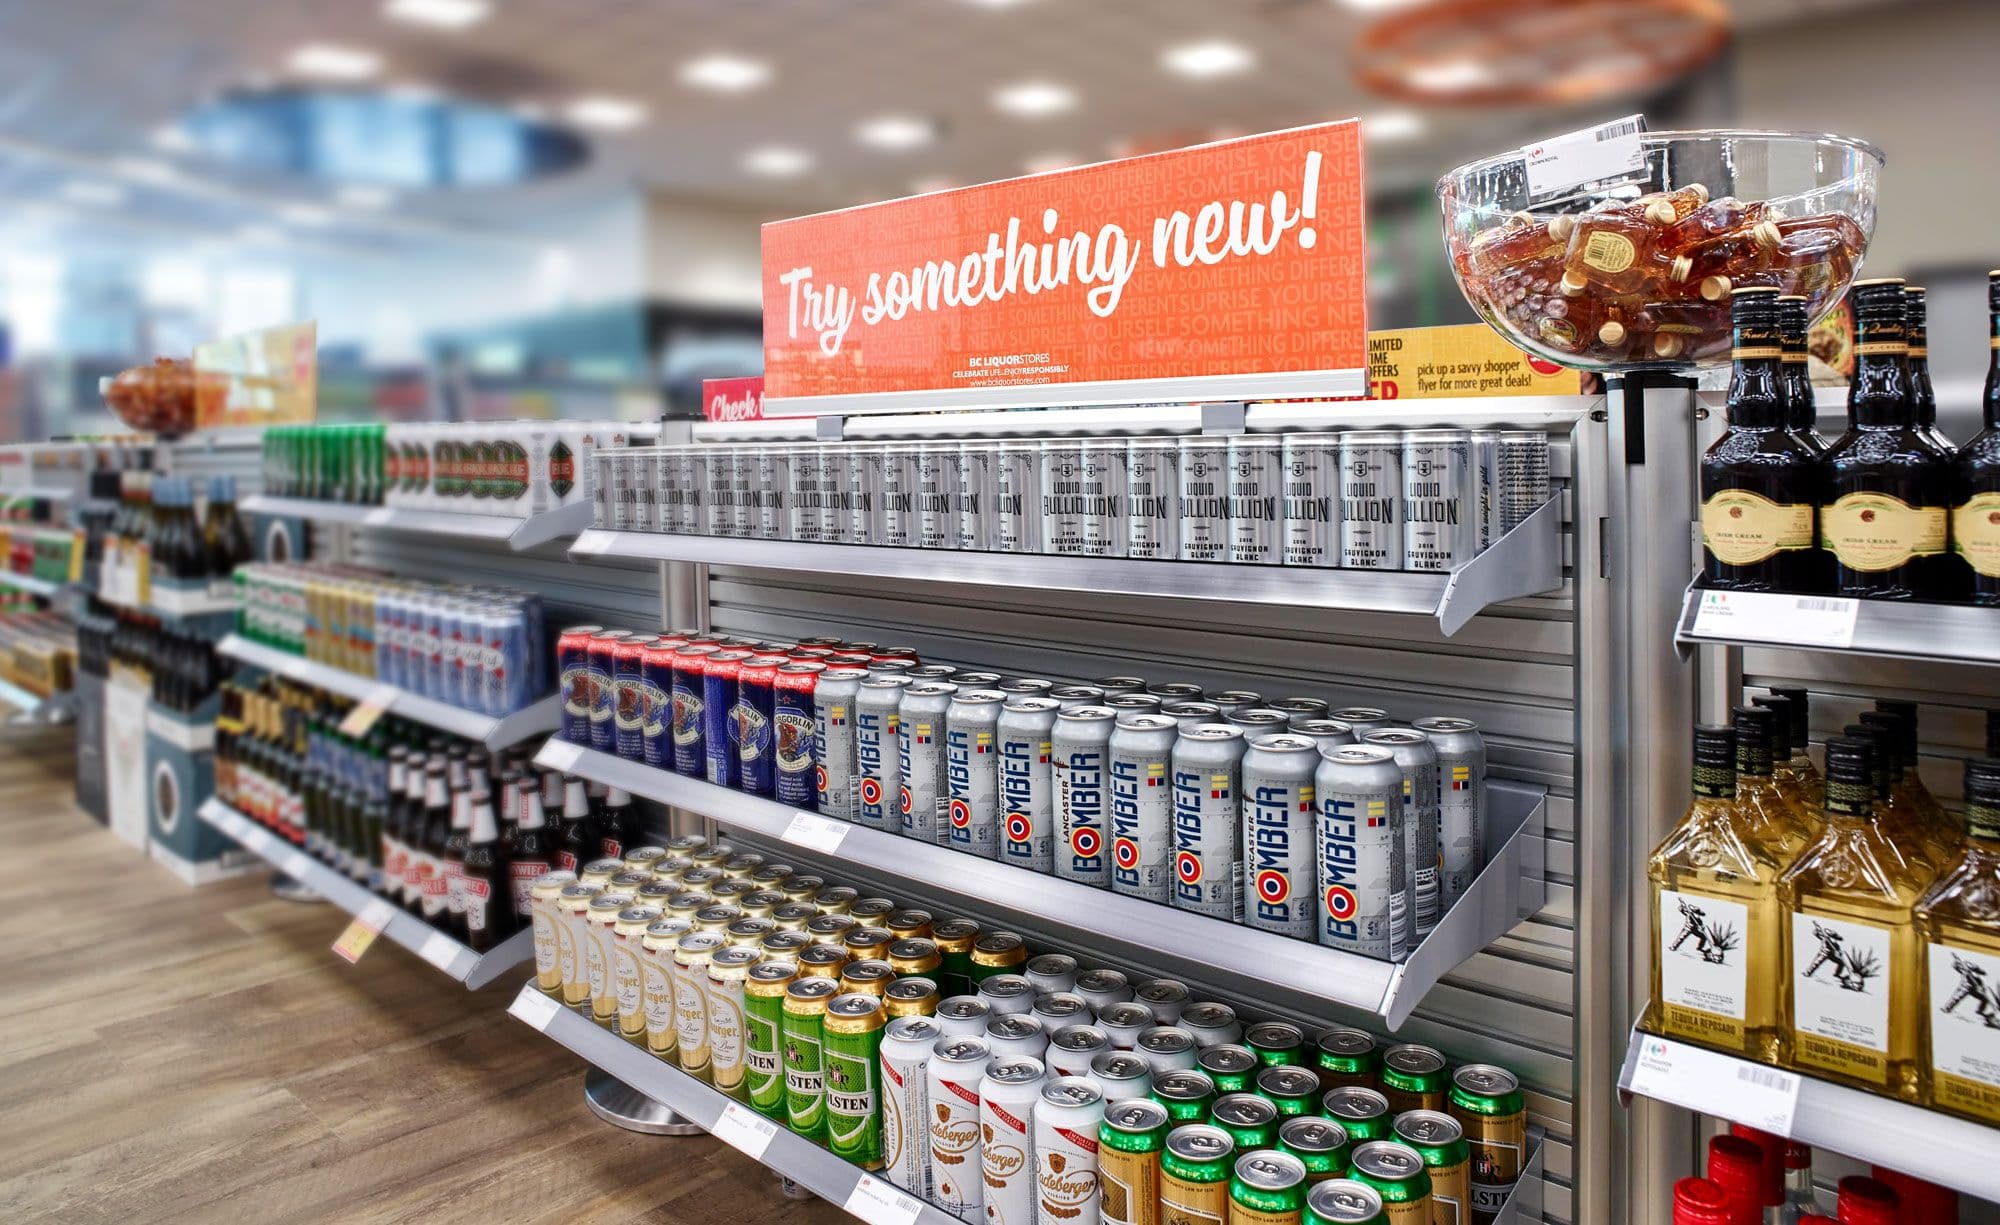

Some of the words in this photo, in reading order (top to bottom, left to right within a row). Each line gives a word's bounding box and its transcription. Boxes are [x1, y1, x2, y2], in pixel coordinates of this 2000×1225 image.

[780, 267, 856, 356] Try
[863, 208, 1140, 318] something
[1153, 150, 1322, 268] new!
[969, 358, 982, 367] BC
[984, 353, 1050, 367] LIQUORSTORES
[953, 369, 988, 378] CELEBRATE
[1417, 364, 1434, 378] pick
[1437, 364, 1448, 378] up
[1451, 365, 1455, 373] a
[1457, 362, 1481, 378] savvy
[1484, 359, 1520, 377] shopper
[1418, 378, 1437, 394] flyer
[1439, 377, 1451, 390] for
[1454, 379, 1477, 390] more
[1480, 377, 1502, 393] great
[1505, 376, 1532, 388] deals!
[711, 390, 758, 422] Check
[1053, 481, 1081, 495] LIQUID
[1186, 482, 1214, 496] LIQUID
[1232, 482, 1258, 496] LIQUID
[1286, 482, 1312, 497] LIQUID
[1346, 482, 1376, 497] LIQUID
[1409, 482, 1440, 498] LIQUID
[1043, 496, 1083, 517] BULLIO
[1191, 551, 1216, 559] BLANC
[1236, 553, 1259, 561] BLANC
[1290, 556, 1313, 564] BLANC
[1344, 549, 1387, 557] SAUVIGNON
[1408, 551, 1452, 559] SAUVIGNON
[1351, 558, 1377, 566] BLANC
[1414, 561, 1442, 569] BLANC
[859, 714, 882, 819] BOMBER
[949, 731, 971, 843] BOMBER
[1004, 741, 1032, 858] BOMBER
[1070, 753, 1102, 873] BOMBER
[1114, 761, 1140, 887] BOMBER
[1175, 771, 1203, 903] BOMBER
[1256, 786, 1291, 922] BOMBER
[1324, 798, 1358, 941] BOMBER
[747, 1053, 775, 1069] STEN
[786, 1071, 822, 1089] LSTEN
[828, 1094, 869, 1111] LSTEN
